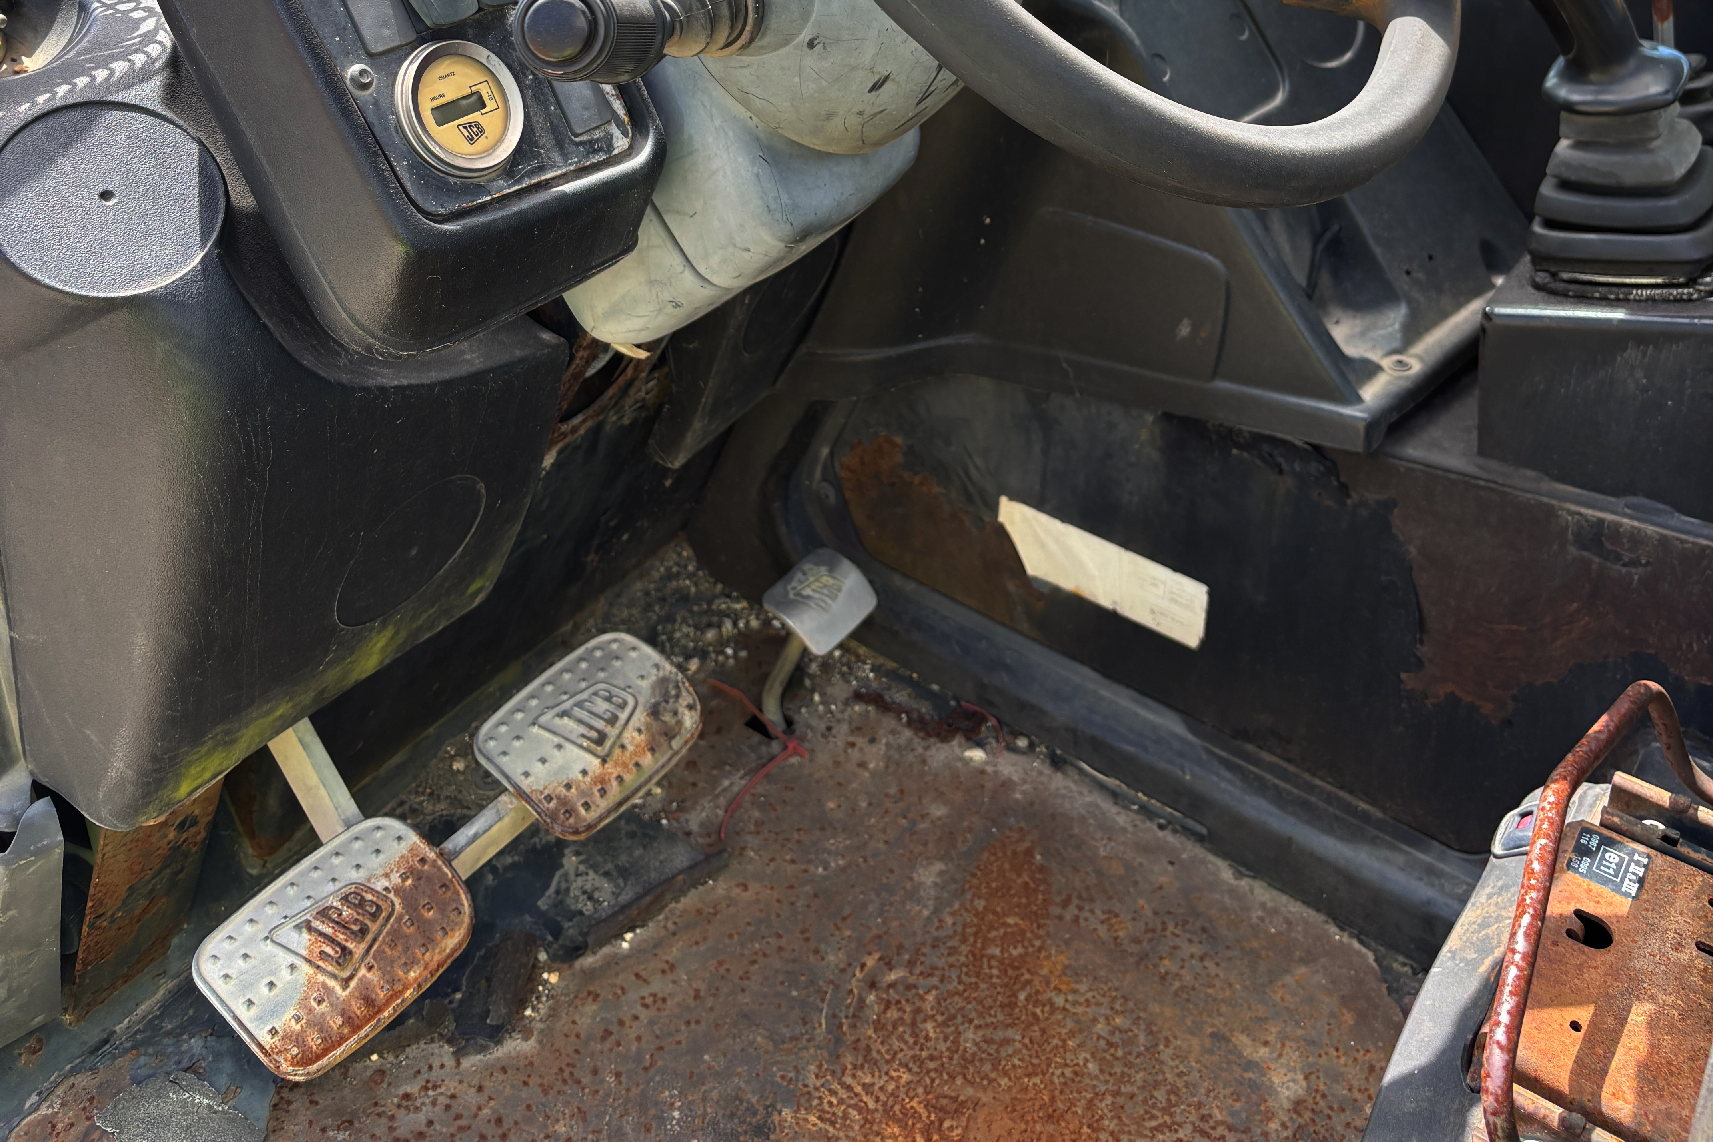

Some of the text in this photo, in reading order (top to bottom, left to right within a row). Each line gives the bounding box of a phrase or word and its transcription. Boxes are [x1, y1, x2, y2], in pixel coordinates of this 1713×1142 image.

[462, 122, 485, 142] JCB
[556, 688, 628, 748] JCB
[293, 891, 383, 967] JCB
